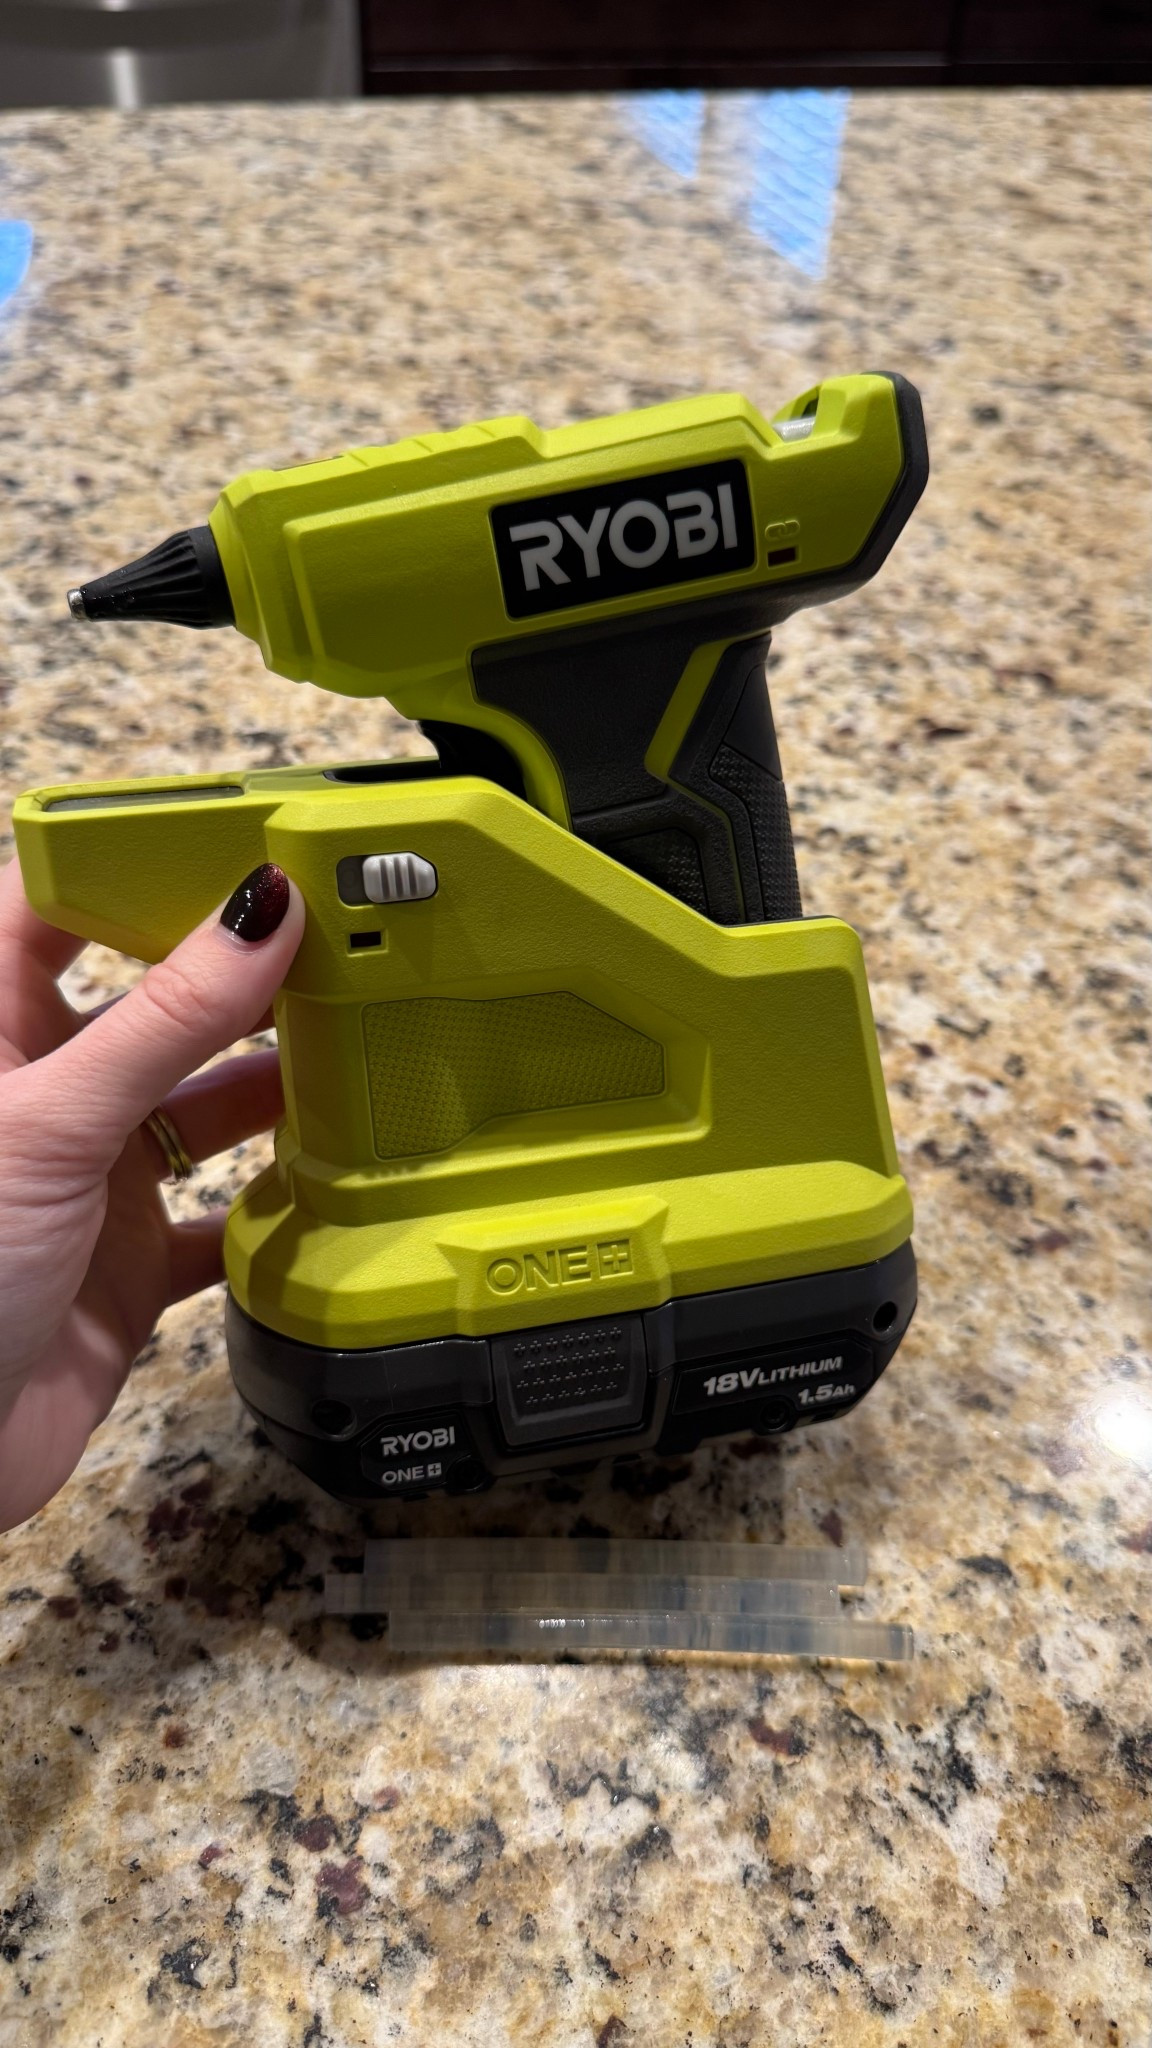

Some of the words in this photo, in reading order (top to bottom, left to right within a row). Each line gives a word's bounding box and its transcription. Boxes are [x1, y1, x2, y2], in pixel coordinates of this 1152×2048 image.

[509, 482, 738, 591] RYOBI
[798, 1383, 856, 1405] 1.5Ah
[380, 1426, 456, 1456] RYOBI
